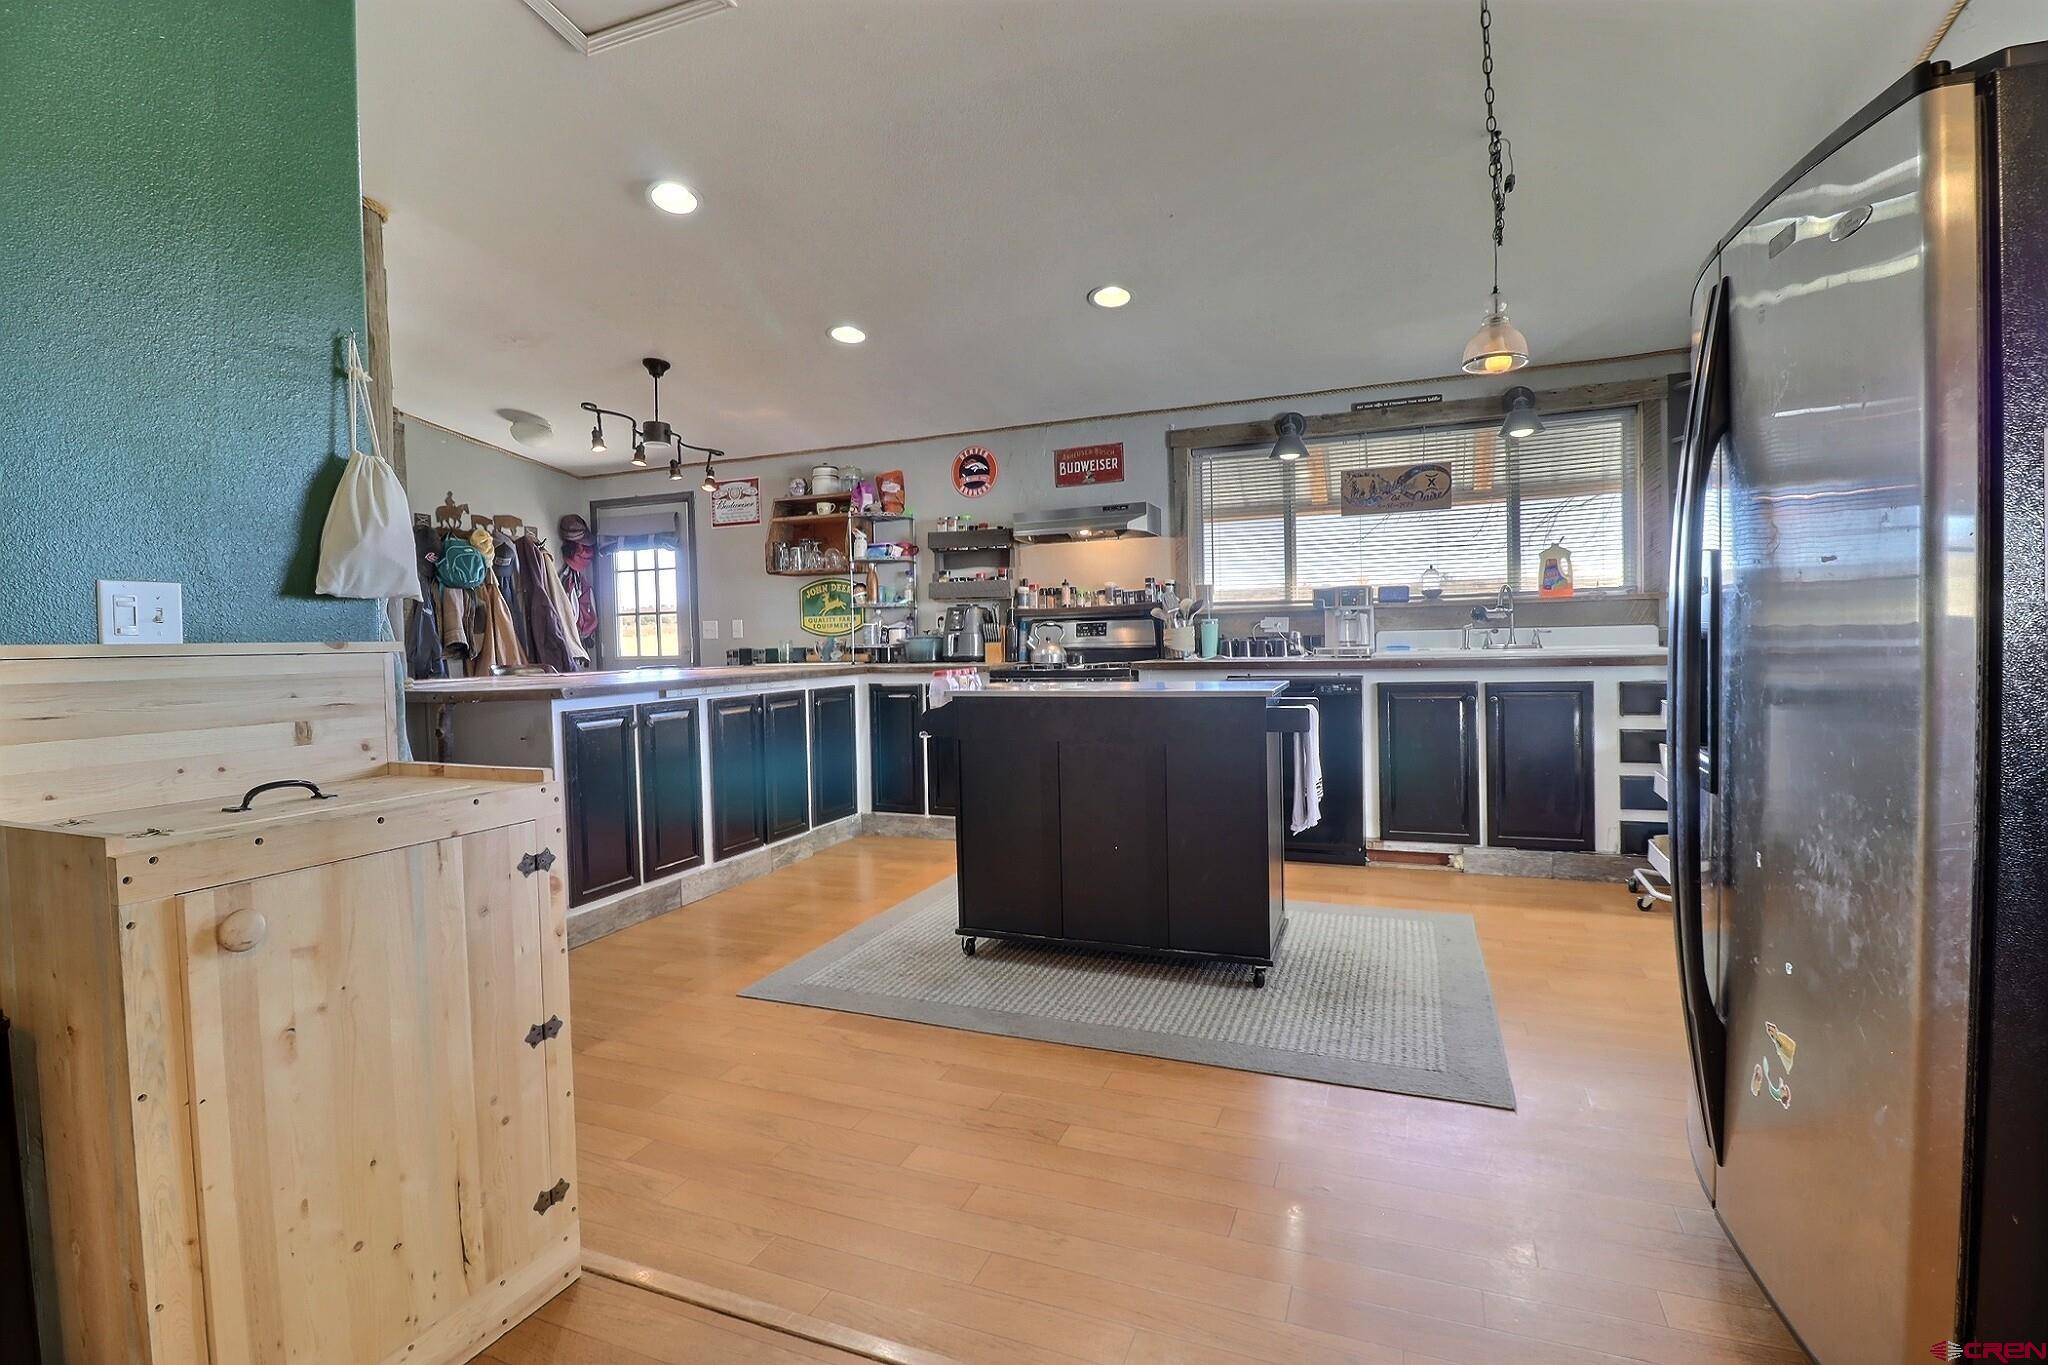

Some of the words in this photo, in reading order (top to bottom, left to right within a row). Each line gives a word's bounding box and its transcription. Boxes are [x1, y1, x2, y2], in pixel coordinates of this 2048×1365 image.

[1060, 457, 1118, 476] BUDWEISER
[806, 584, 828, 598] JOHN
[831, 584, 851, 594] DEER
